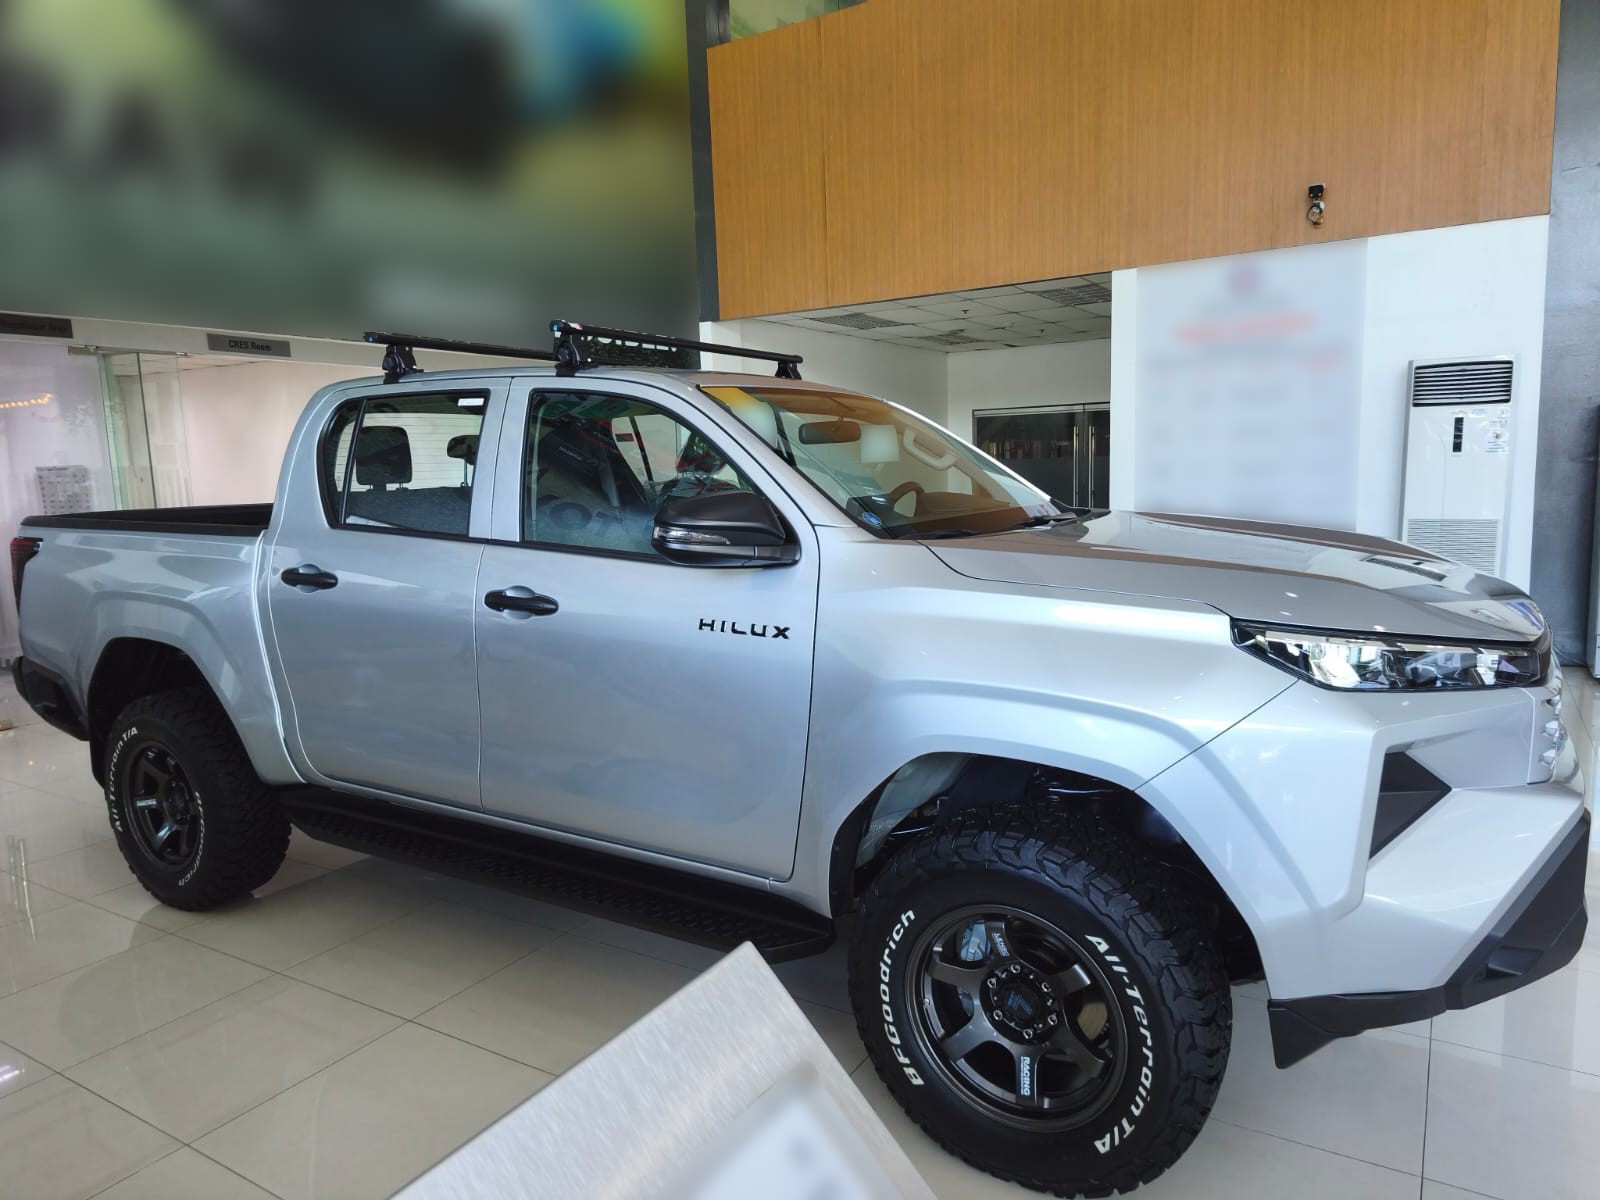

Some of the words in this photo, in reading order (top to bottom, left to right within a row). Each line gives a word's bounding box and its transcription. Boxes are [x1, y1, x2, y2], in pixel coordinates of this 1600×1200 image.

[228, 340, 249, 350] CRES
[251, 341, 272, 351] Room
[699, 618, 790, 640] HILUX
[880, 909, 925, 1086] BFGoodrich
[1085, 935, 1153, 1117] All-Terrain
[1094, 1117, 1135, 1154] T/A
